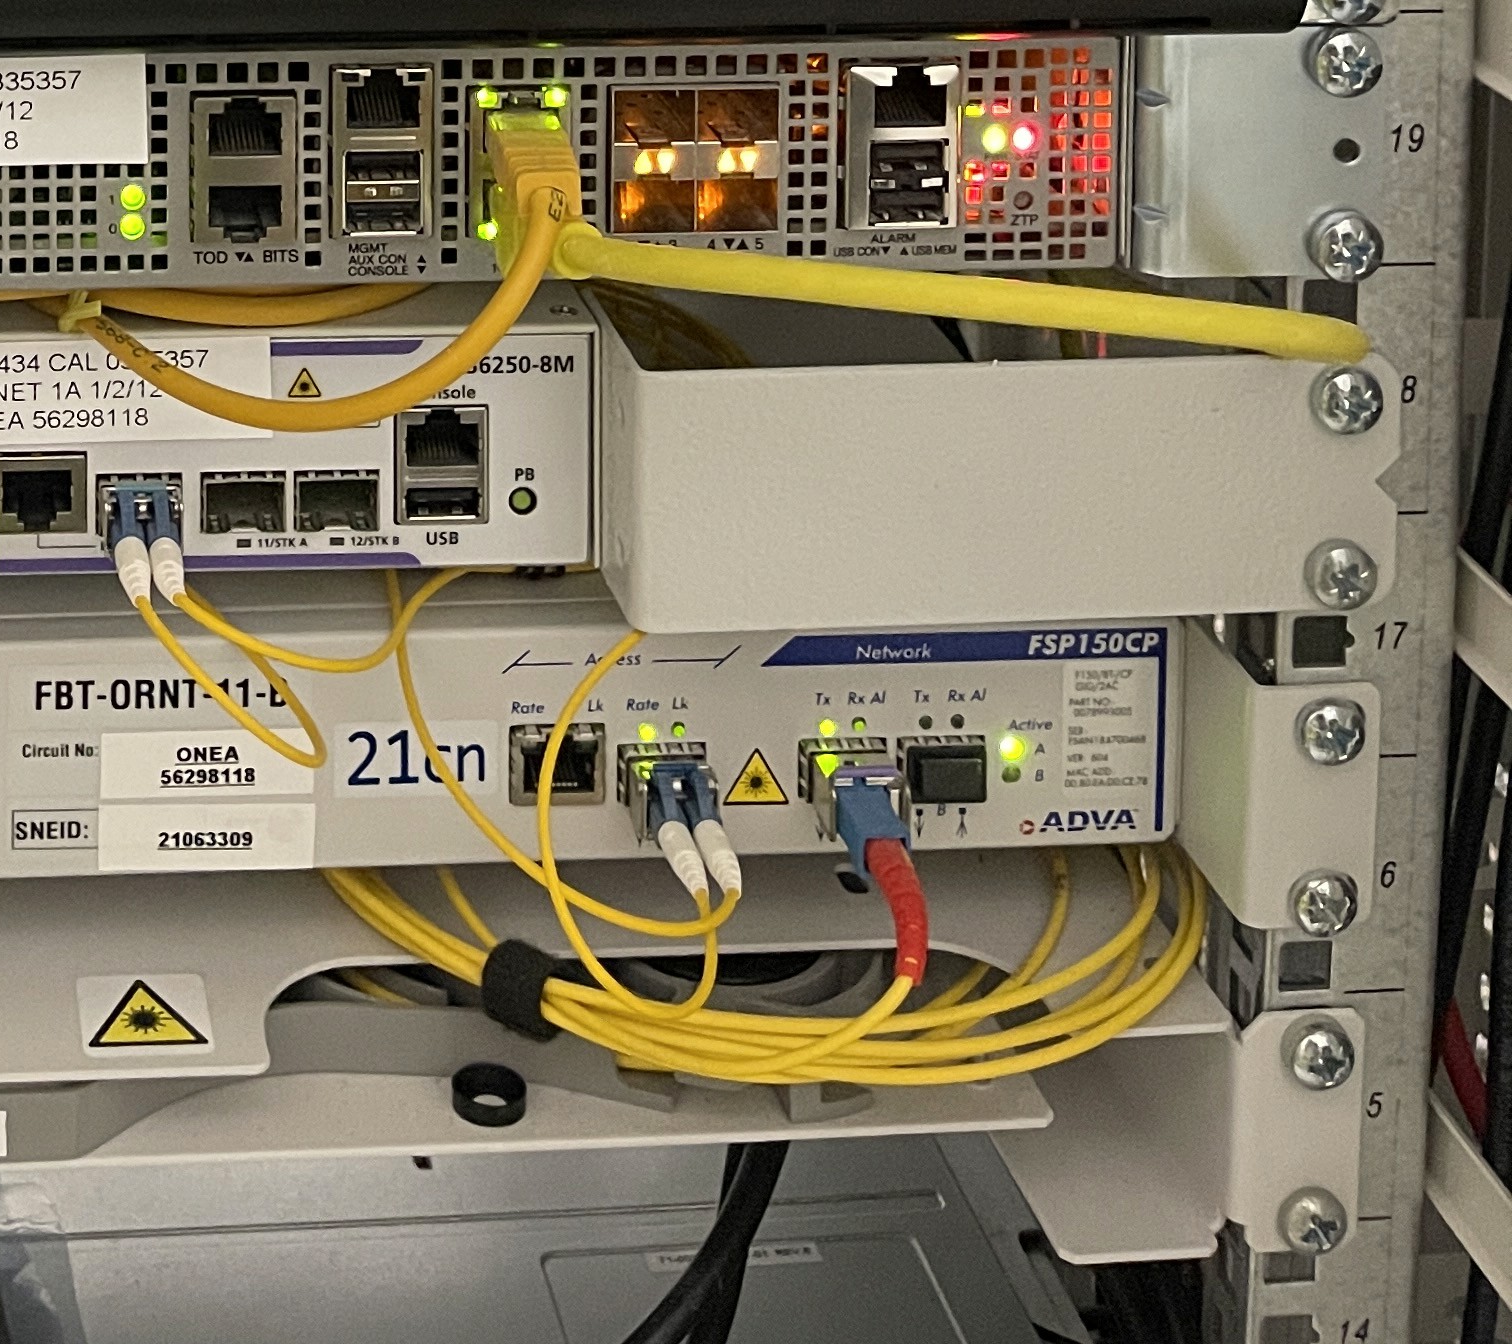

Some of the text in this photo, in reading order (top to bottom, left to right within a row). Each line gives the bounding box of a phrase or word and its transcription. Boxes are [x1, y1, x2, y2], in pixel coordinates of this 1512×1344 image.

[1391, 123, 1425, 153] 19
[1010, 214, 1039, 227] ZTP
[871, 233, 916, 244] ALARM
[348, 243, 387, 254] MGMT
[193, 249, 299, 264] TOD BITS
[348, 253, 407, 265] AUX CON
[348, 265, 409, 276] CONSOLE
[48, 351, 98, 372] CAL
[51, 380, 81, 400] 1A
[32, 407, 149, 430] 56298118
[514, 468, 535, 482] PB
[257, 537, 296, 548] 11/STK
[351, 536, 388, 547] 12/STK
[426, 531, 459, 546] USB
[1373, 621, 1407, 650] 17
[856, 632, 1160, 661] Network FSP150CP
[626, 696, 689, 711] Rate Lk
[815, 691, 865, 706] Tx Rx
[914, 689, 965, 703] Tx Rx
[511, 700, 545, 714] Rate
[1009, 718, 1053, 731] Active
[21, 744, 70, 758] Circuit
[176, 746, 239, 762] ONEA
[1034, 743, 1046, 755] A
[160, 768, 255, 785] 56298118
[1034, 769, 1044, 782] B
[1039, 809, 1137, 833] ADVA
[15, 820, 89, 841] SNEID:
[158, 831, 253, 849] 21063309
[1341, 1318, 1370, 1344] 14
